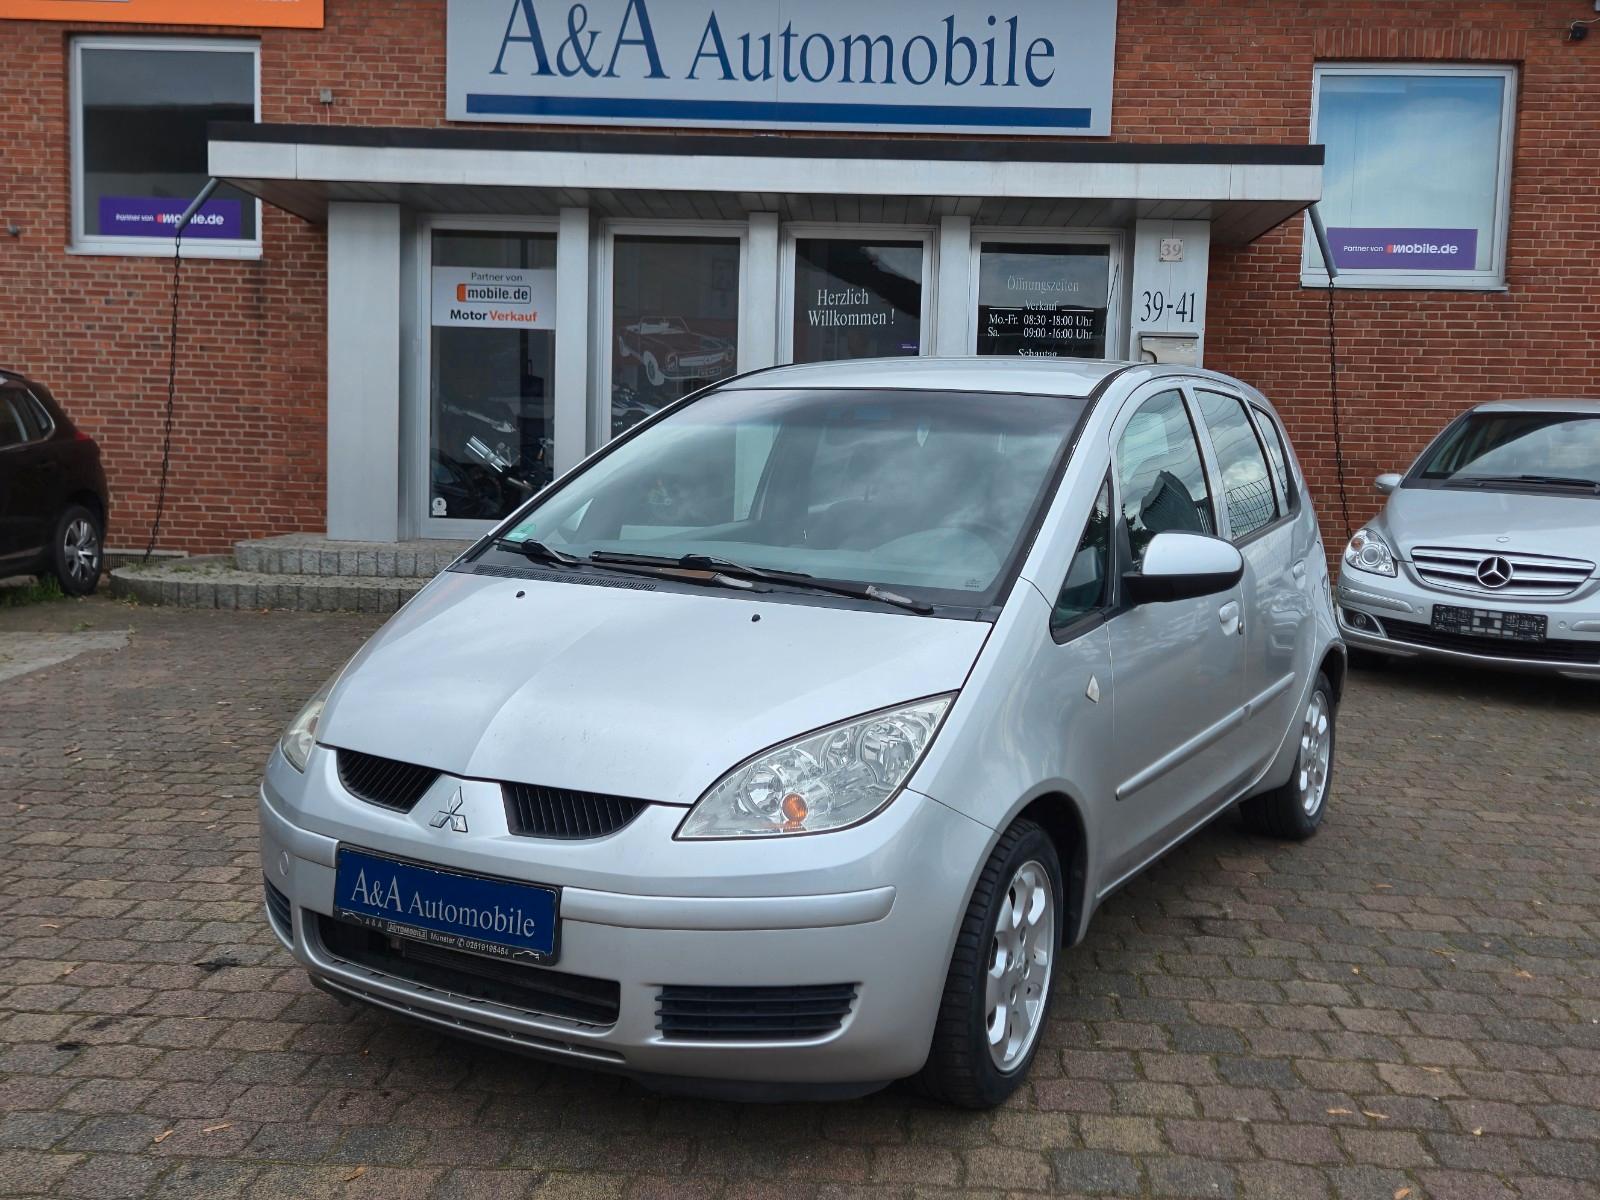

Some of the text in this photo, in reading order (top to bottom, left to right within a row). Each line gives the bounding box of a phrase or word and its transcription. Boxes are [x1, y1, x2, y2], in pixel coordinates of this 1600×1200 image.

[489, 0, 1056, 87] A&A Automobile
[162, 213, 224, 225] moile.de
[1162, 243, 1181, 257] 39
[1392, 243, 1458, 254] mobile.de
[471, 272, 504, 281] Partner
[467, 287, 528, 300] mobile.de
[817, 288, 869, 306] Herzlich
[1025, 299, 1059, 311] Verkauf
[1140, 291, 1195, 323] 39-41
[450, 309, 537, 322] Motor Verkauf
[808, 308, 887, 327] Willkommen
[989, 313, 1019, 325] Mo.-Fr.
[1023, 314, 1046, 326] 08:30
[1076, 315, 1093, 327] Uhr
[987, 326, 1000, 337] Sa.
[1023, 327, 1046, 338] 09:00
[1076, 329, 1093, 340] Uhr
[351, 867, 535, 938] A&A Automobile
